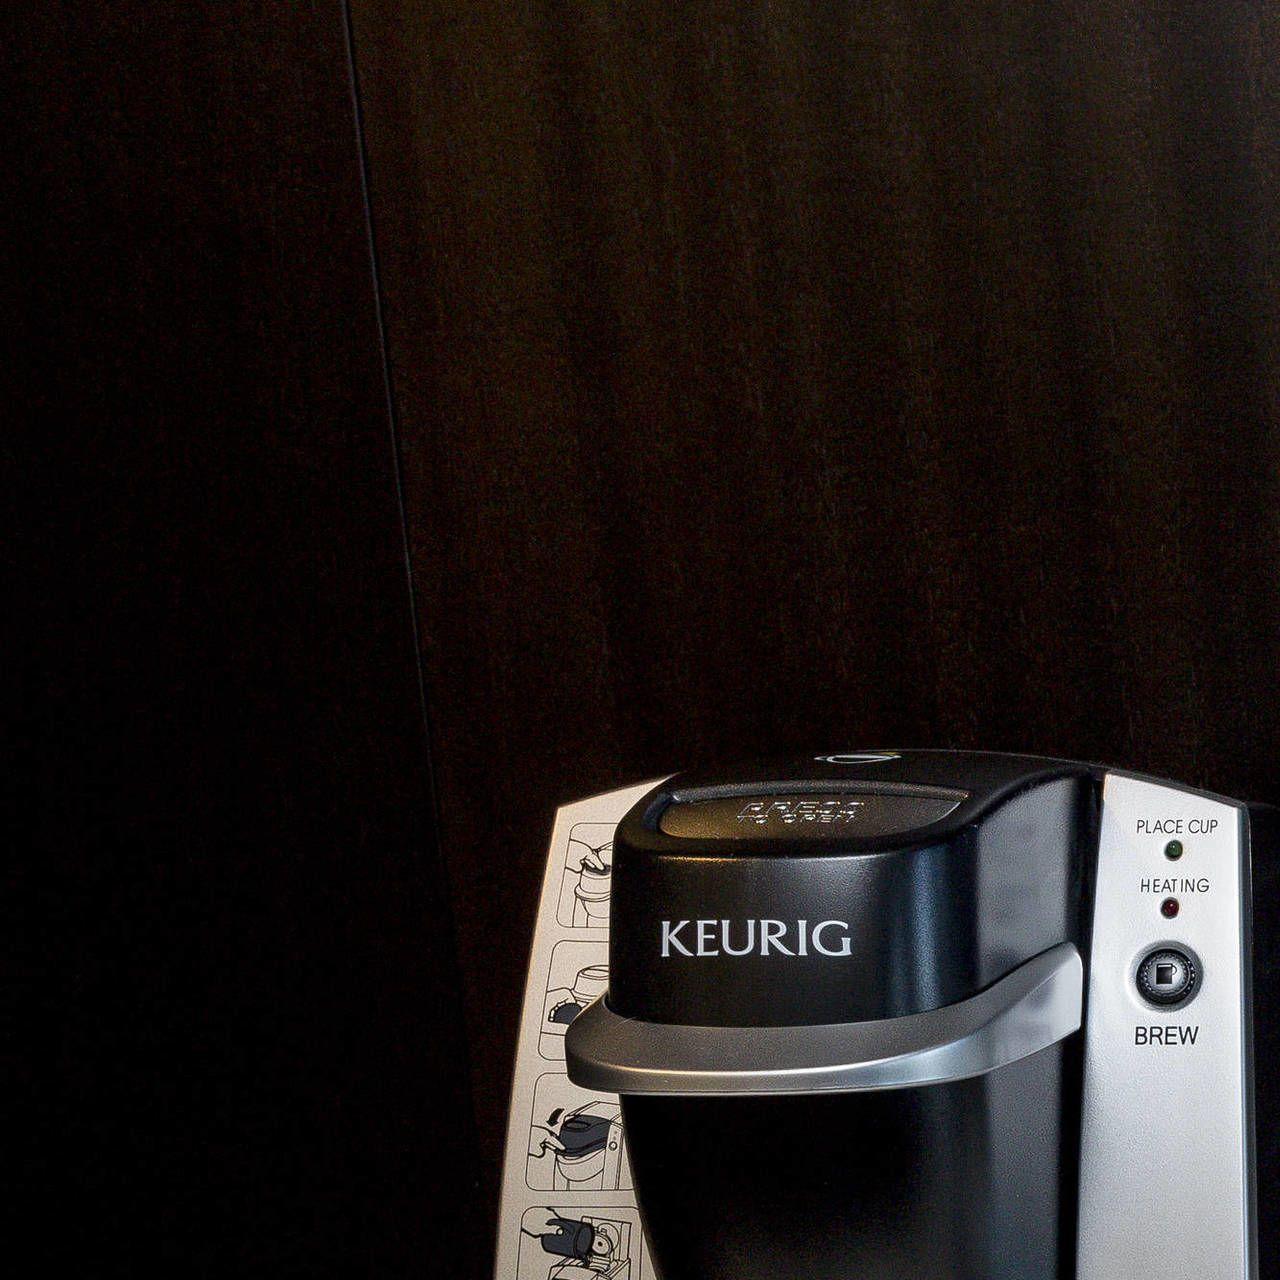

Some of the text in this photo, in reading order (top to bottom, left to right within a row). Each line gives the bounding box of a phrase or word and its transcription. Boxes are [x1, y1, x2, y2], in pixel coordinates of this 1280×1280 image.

[1136, 819, 1218, 834] PLACE CUP
[1140, 878, 1210, 893] HEATING
[661, 919, 853, 958] KEURIG
[1135, 1026, 1199, 1046] BREW
